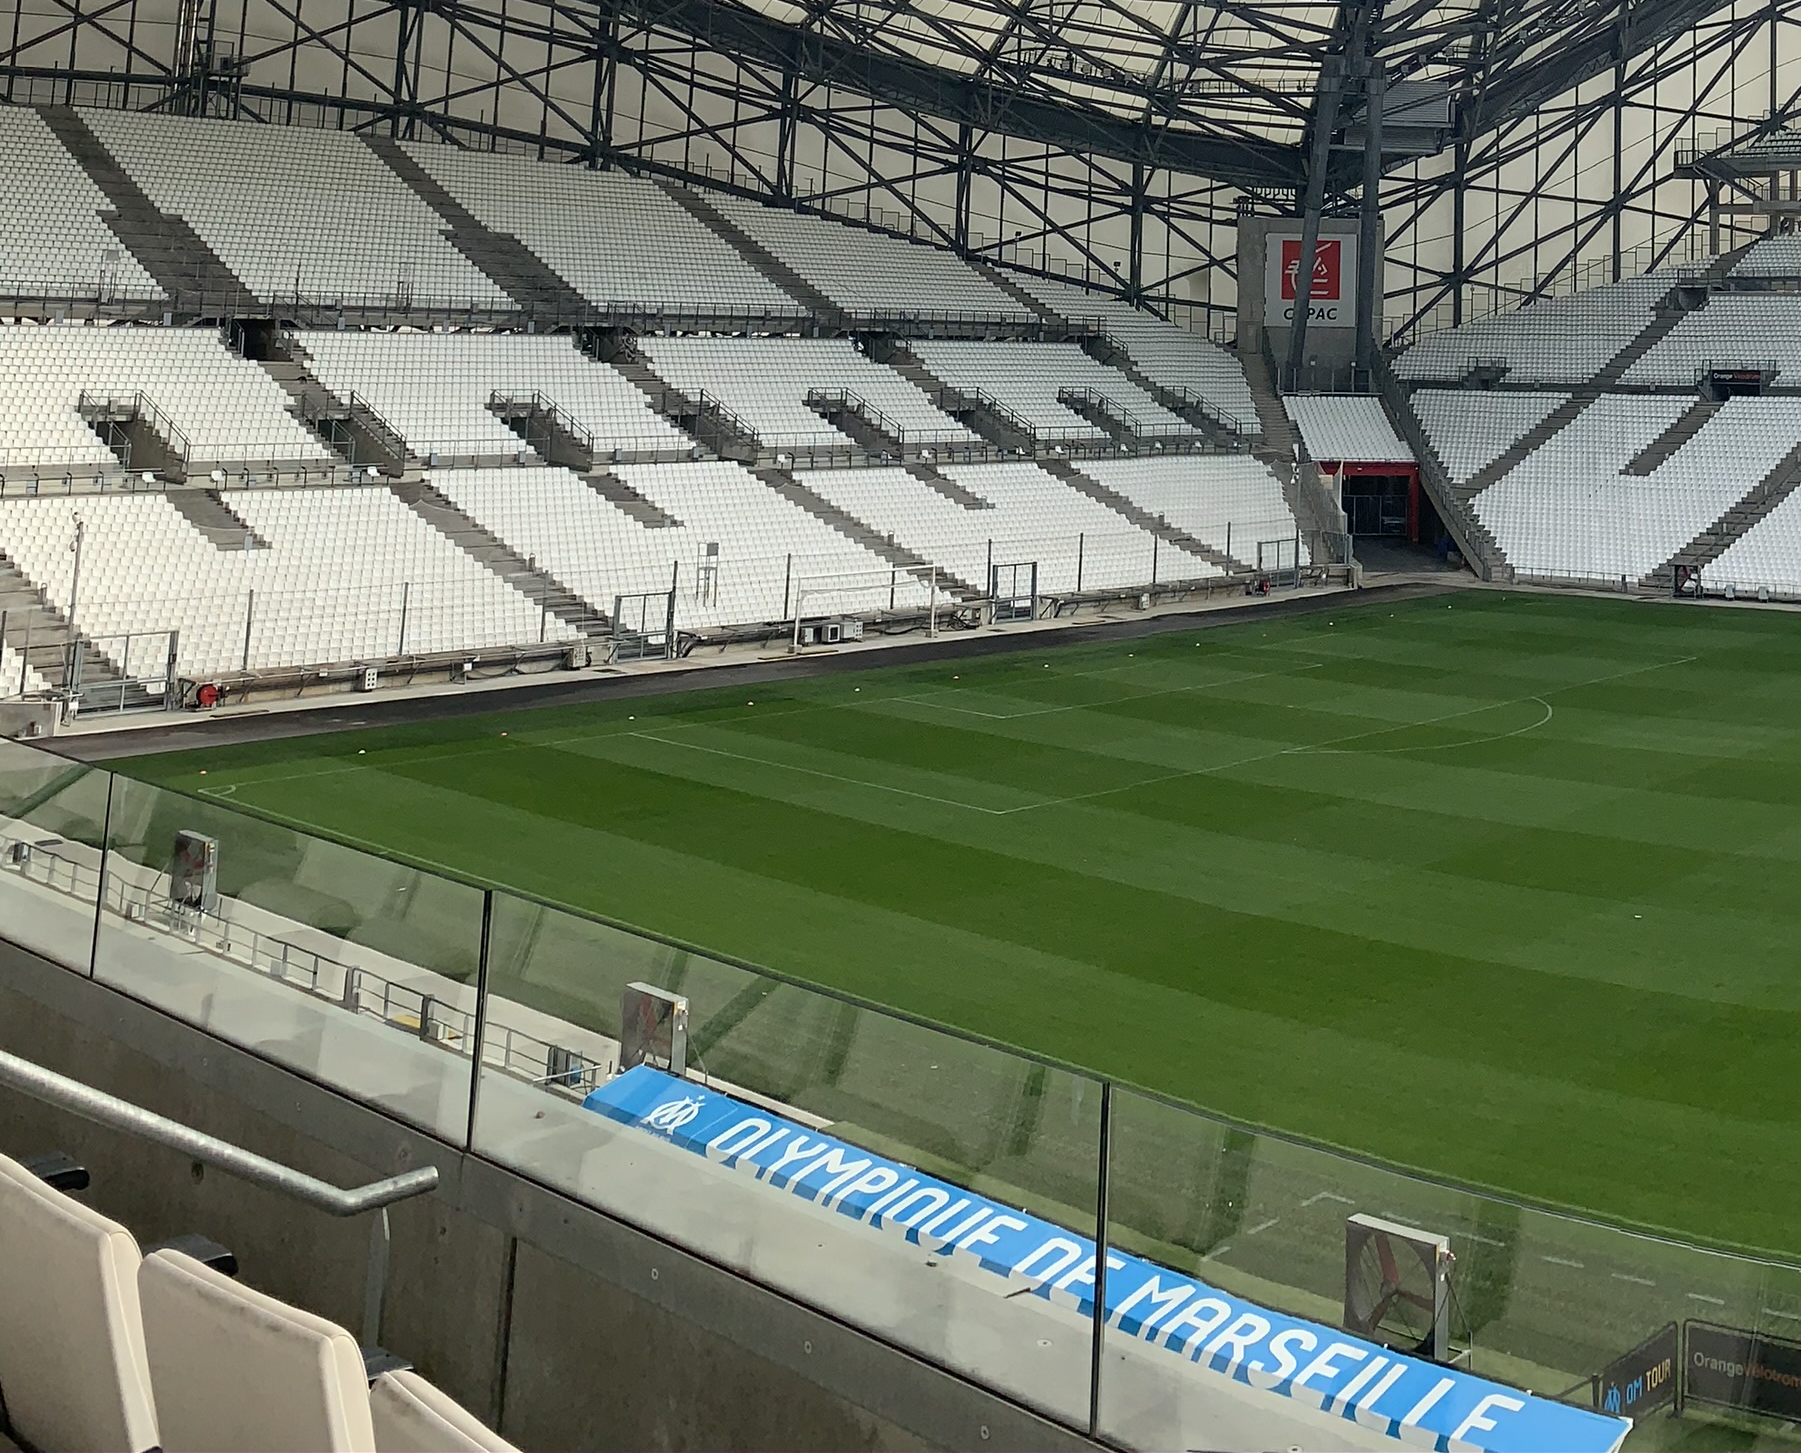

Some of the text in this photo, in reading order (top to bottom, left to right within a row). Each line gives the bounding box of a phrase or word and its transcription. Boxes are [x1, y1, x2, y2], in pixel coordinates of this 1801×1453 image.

[1283, 308, 1337, 320] CPAC
[705, 1117, 1028, 1265] OLYMPIQUE
[1108, 1275, 1525, 1453] MARSEILLE
[1626, 1358, 1671, 1404] OM TOUR
[1694, 1352, 1743, 1377] Orange
